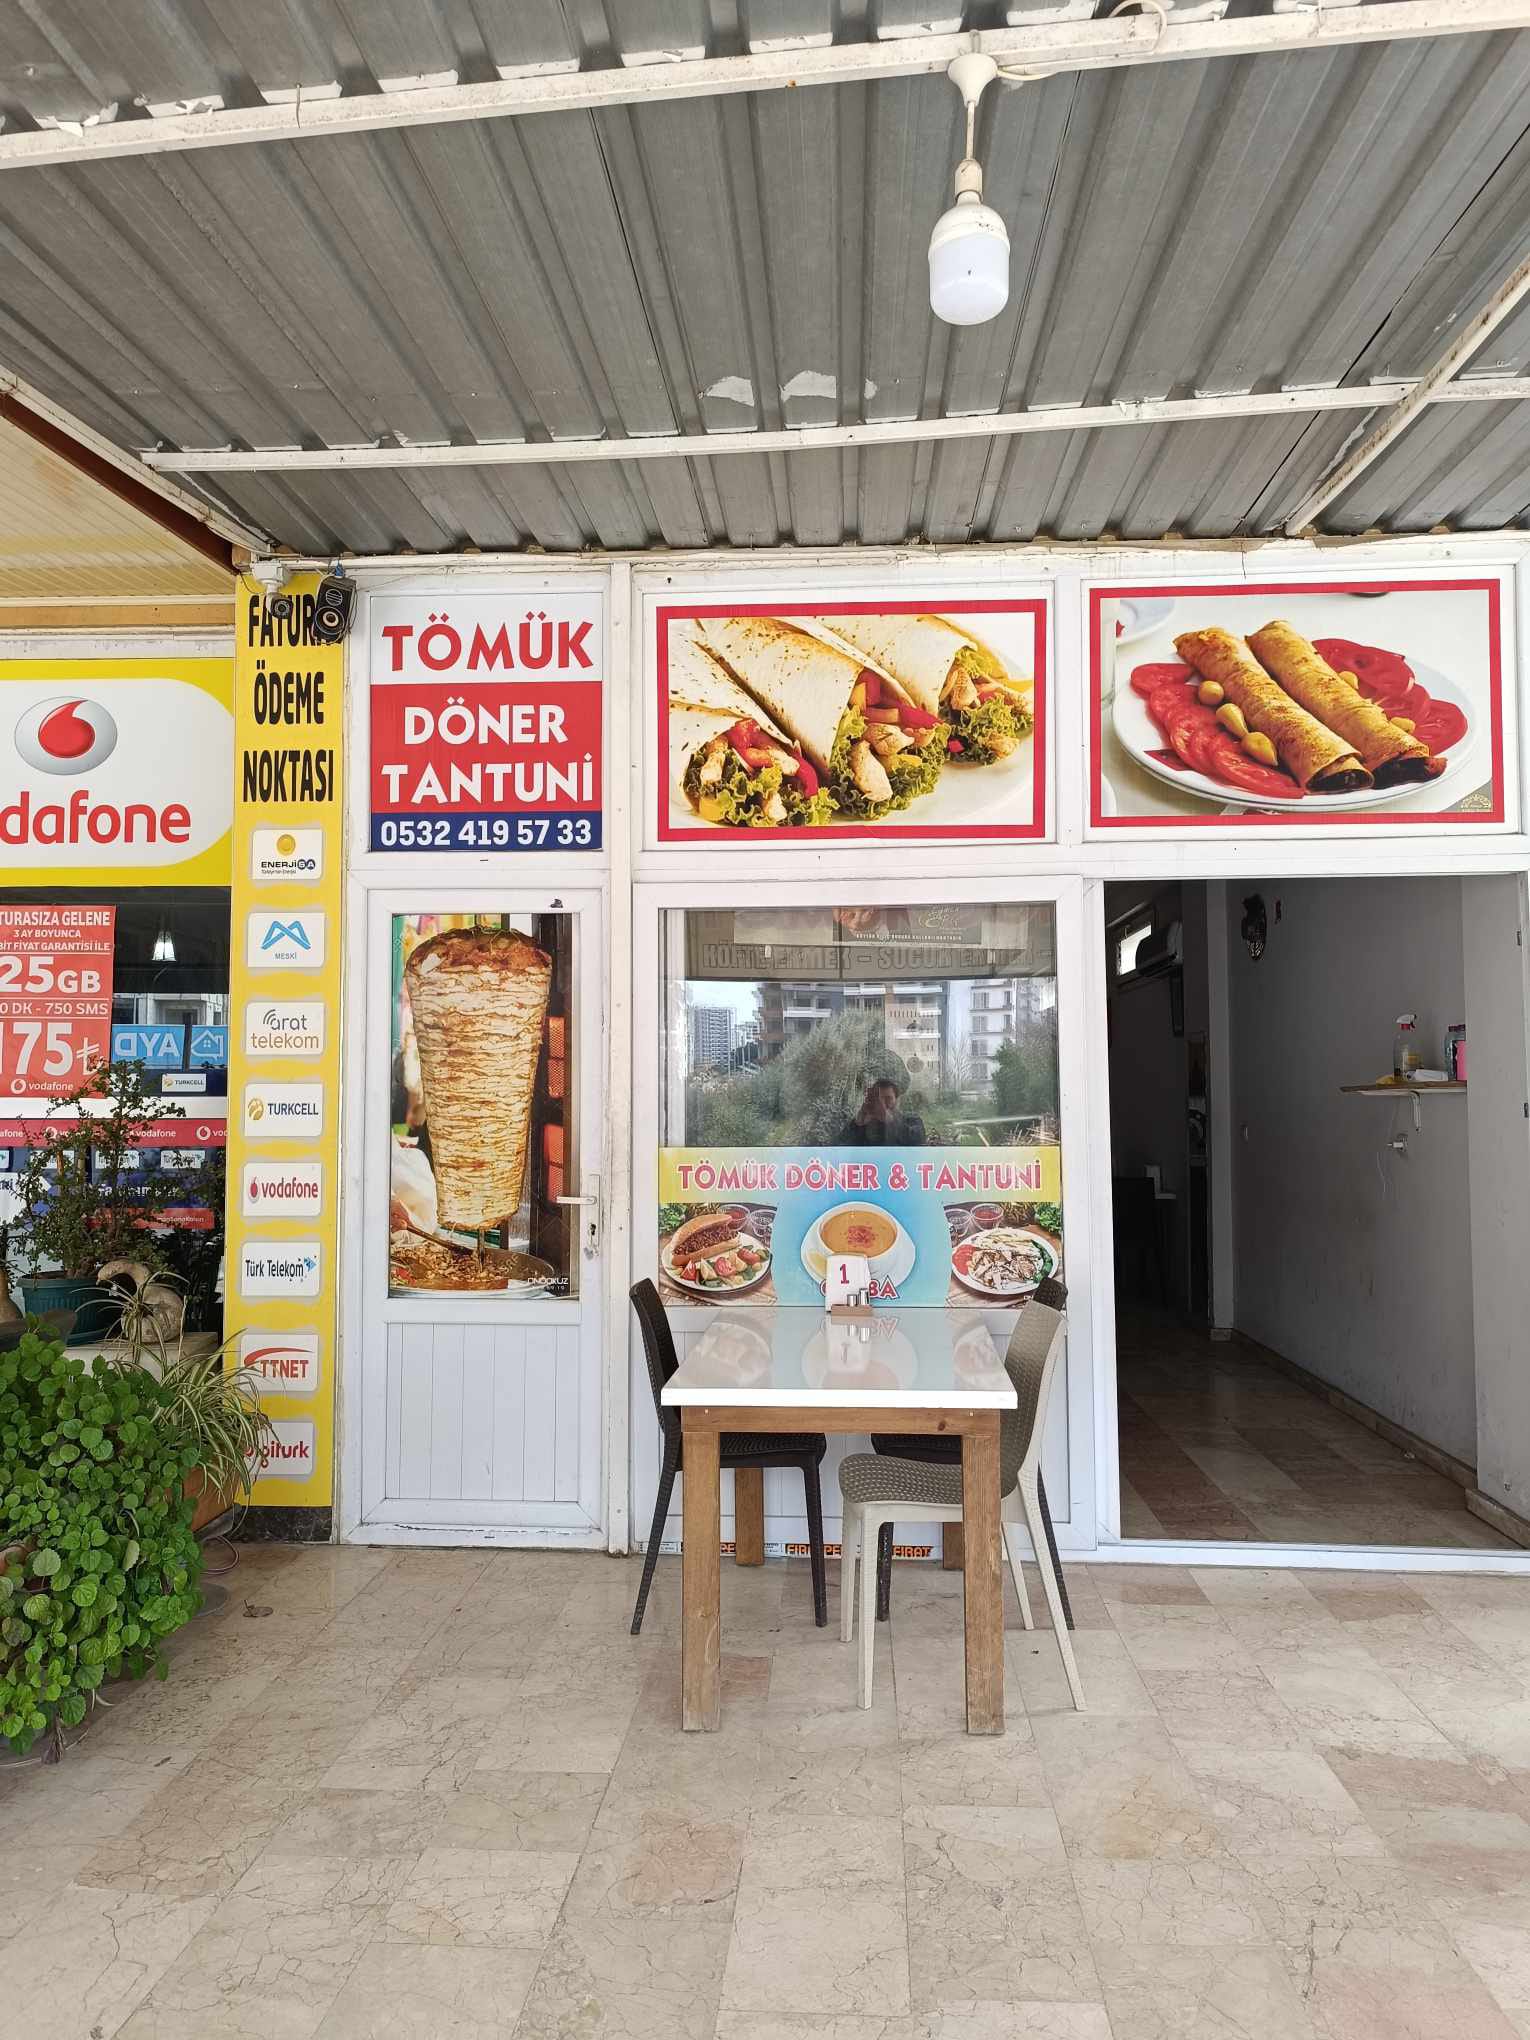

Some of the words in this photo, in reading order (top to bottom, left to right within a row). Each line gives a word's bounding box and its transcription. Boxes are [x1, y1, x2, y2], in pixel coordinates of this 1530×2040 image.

[249, 594, 341, 647] FATUR
[382, 611, 594, 671] TÖMÜK
[254, 660, 324, 725] ÖDEME
[405, 697, 568, 745] DÖNER
[243, 750, 333, 802] NOKTASI
[381, 753, 593, 804] TANTUNİ
[381, 821, 450, 846] 0532
[458, 821, 508, 845] 419
[518, 820, 550, 845] 57
[558, 819, 592, 845] 33
[62, 912, 110, 925] GELENE
[14, 930, 19, 938] 3
[21, 930, 33, 938] AY
[35, 930, 81, 938] BOYUNCA
[14, 940, 39, 951] FİYAT
[40, 939, 93, 951] GARANTİSİ
[95, 939, 110, 951] İLE
[12, 1003, 32, 1014] DK
[45, 1003, 72, 1014] 750
[76, 1003, 108, 1014] SMS
[251, 1033, 319, 1049] telekom
[29, 1081, 74, 1091] vodafone
[268, 1103, 318, 1115] TURKCELL
[136, 1128, 177, 1138] vodafone
[678, 1159, 779, 1191] TÖMÜK
[785, 1158, 880, 1191] DÖNER
[889, 1162, 909, 1191] &
[917, 1160, 1042, 1192] TANTUNİ
[262, 1177, 318, 1198] vodafone
[246, 1260, 264, 1277] Türk
[267, 1259, 303, 1277] Telekom
[840, 1264, 849, 1284] 1
[260, 1360, 308, 1378] TTNET
